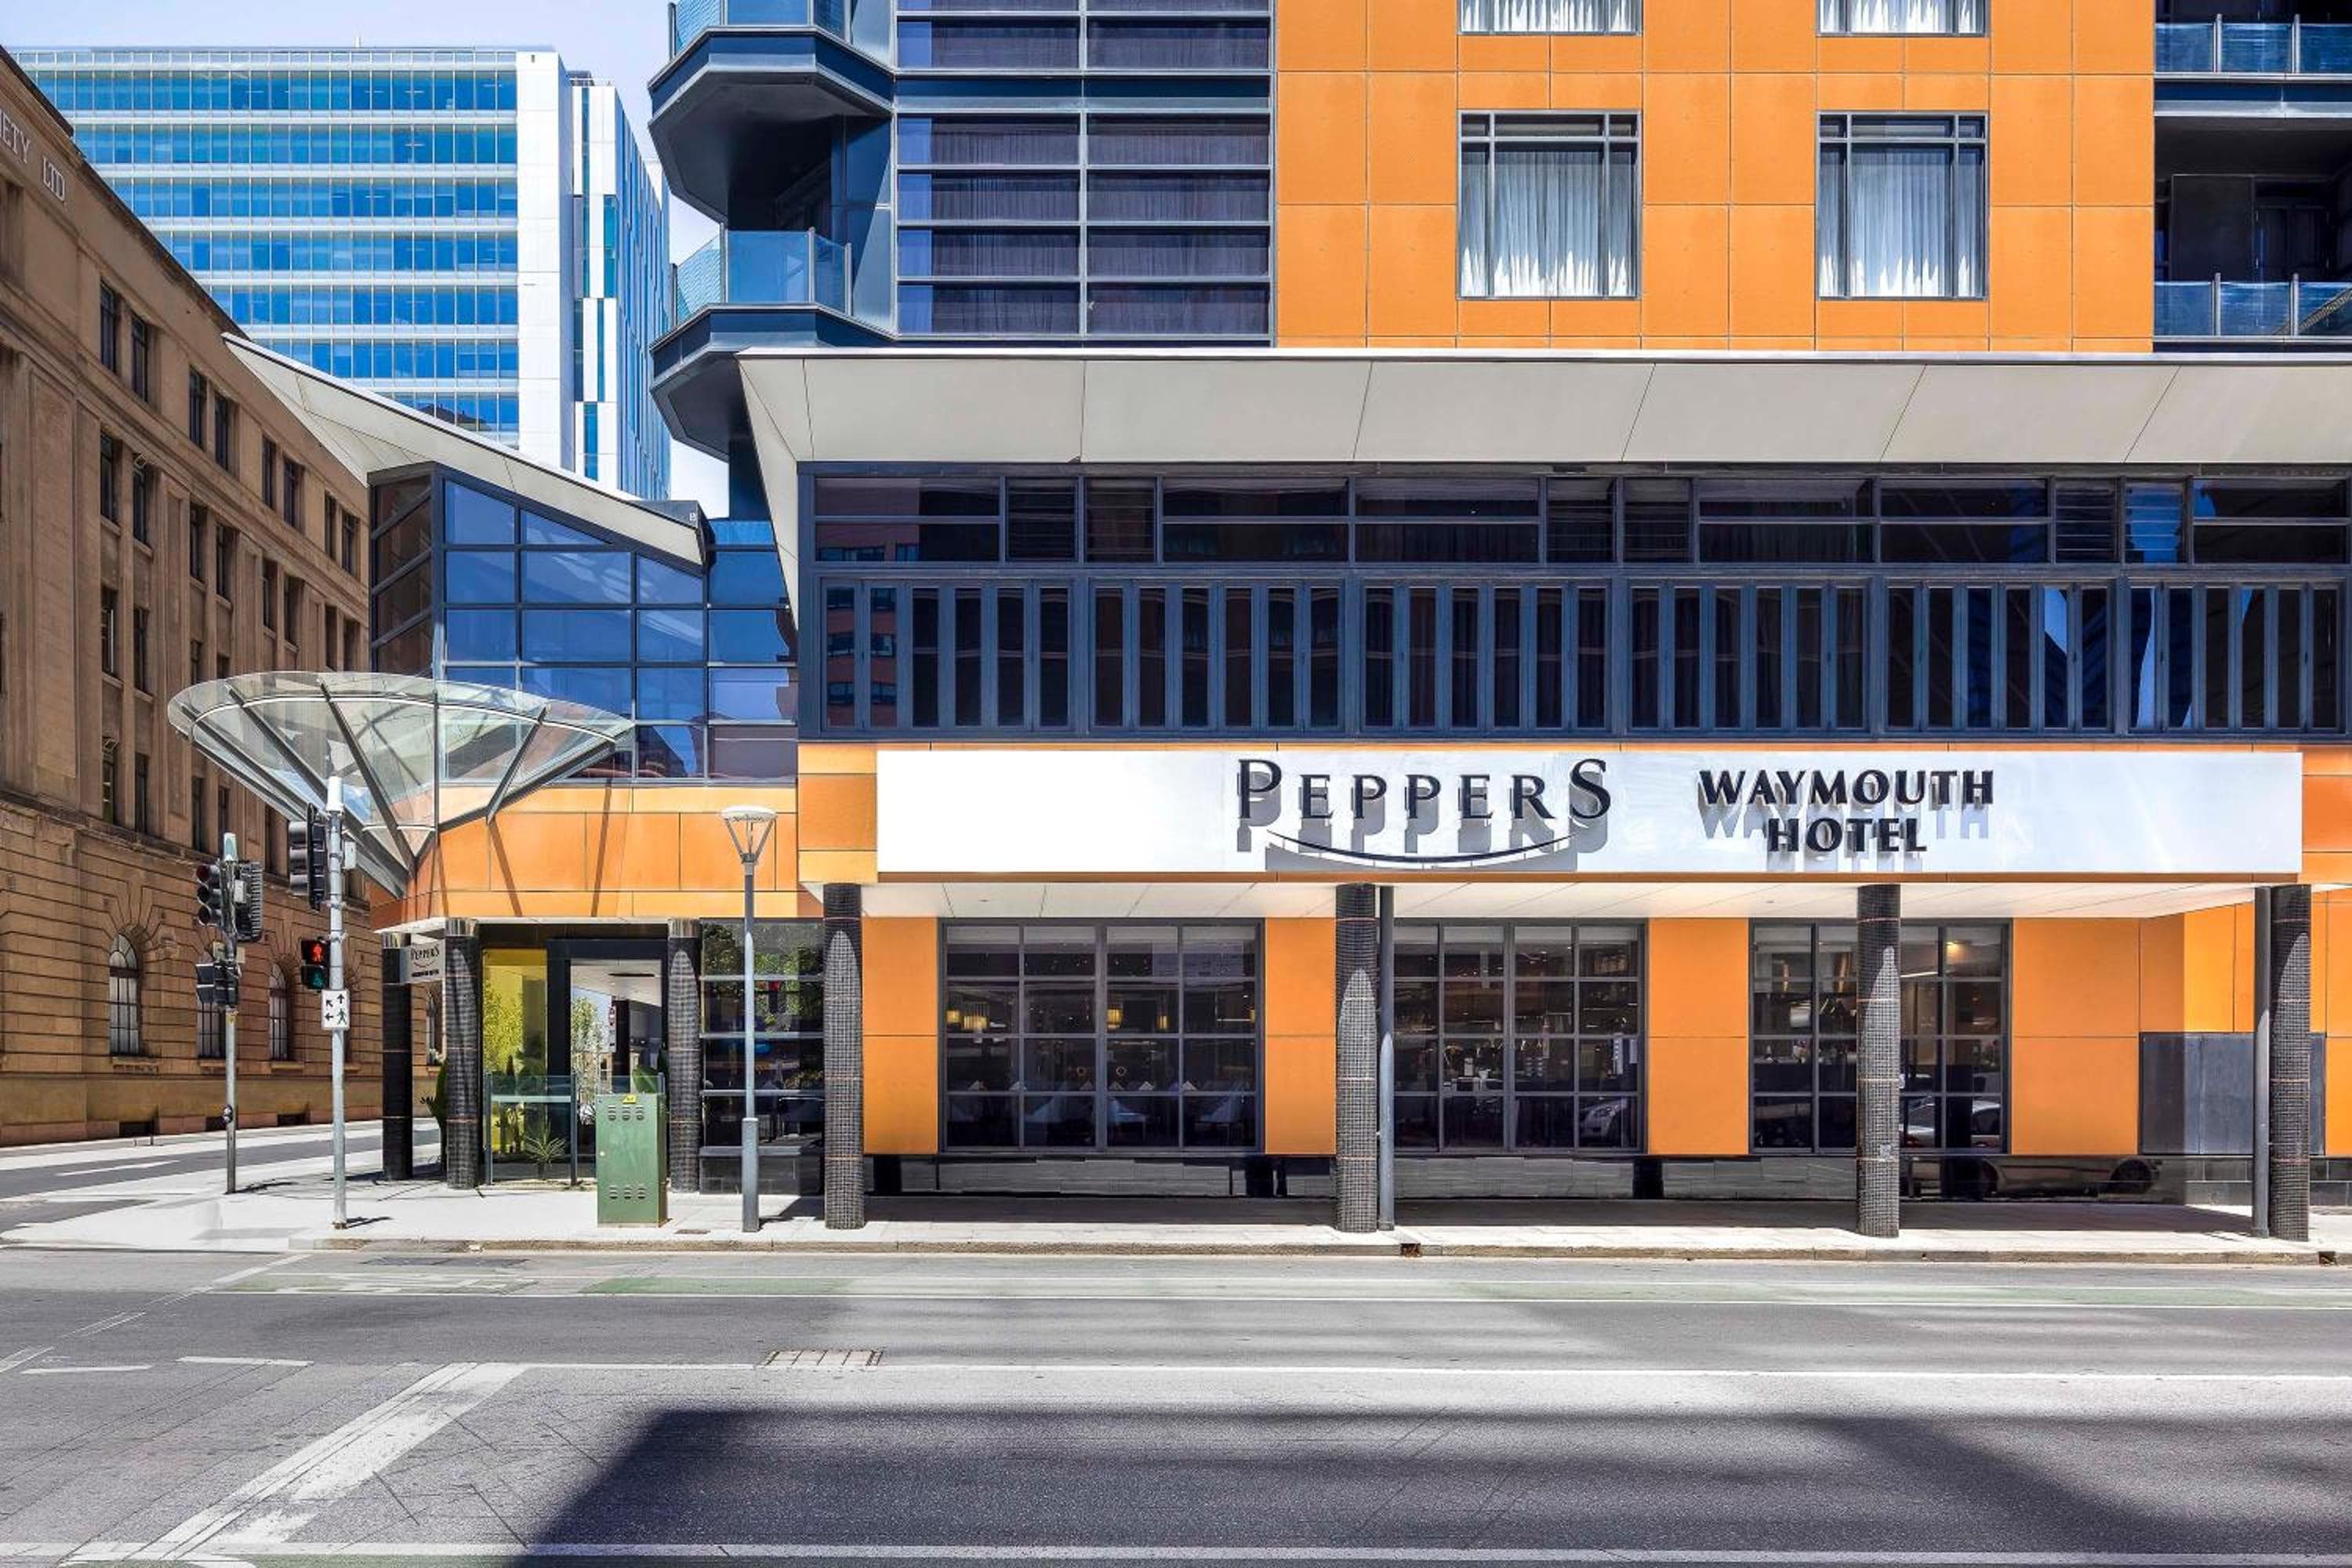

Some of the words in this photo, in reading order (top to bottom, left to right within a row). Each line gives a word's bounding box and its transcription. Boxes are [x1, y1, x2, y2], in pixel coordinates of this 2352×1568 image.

[42, 156, 65, 201] LTD
[1238, 758, 1611, 819] PEPPERS
[1699, 769, 1994, 805] WAYMOUTH
[1767, 817, 1928, 852] HOTEL
